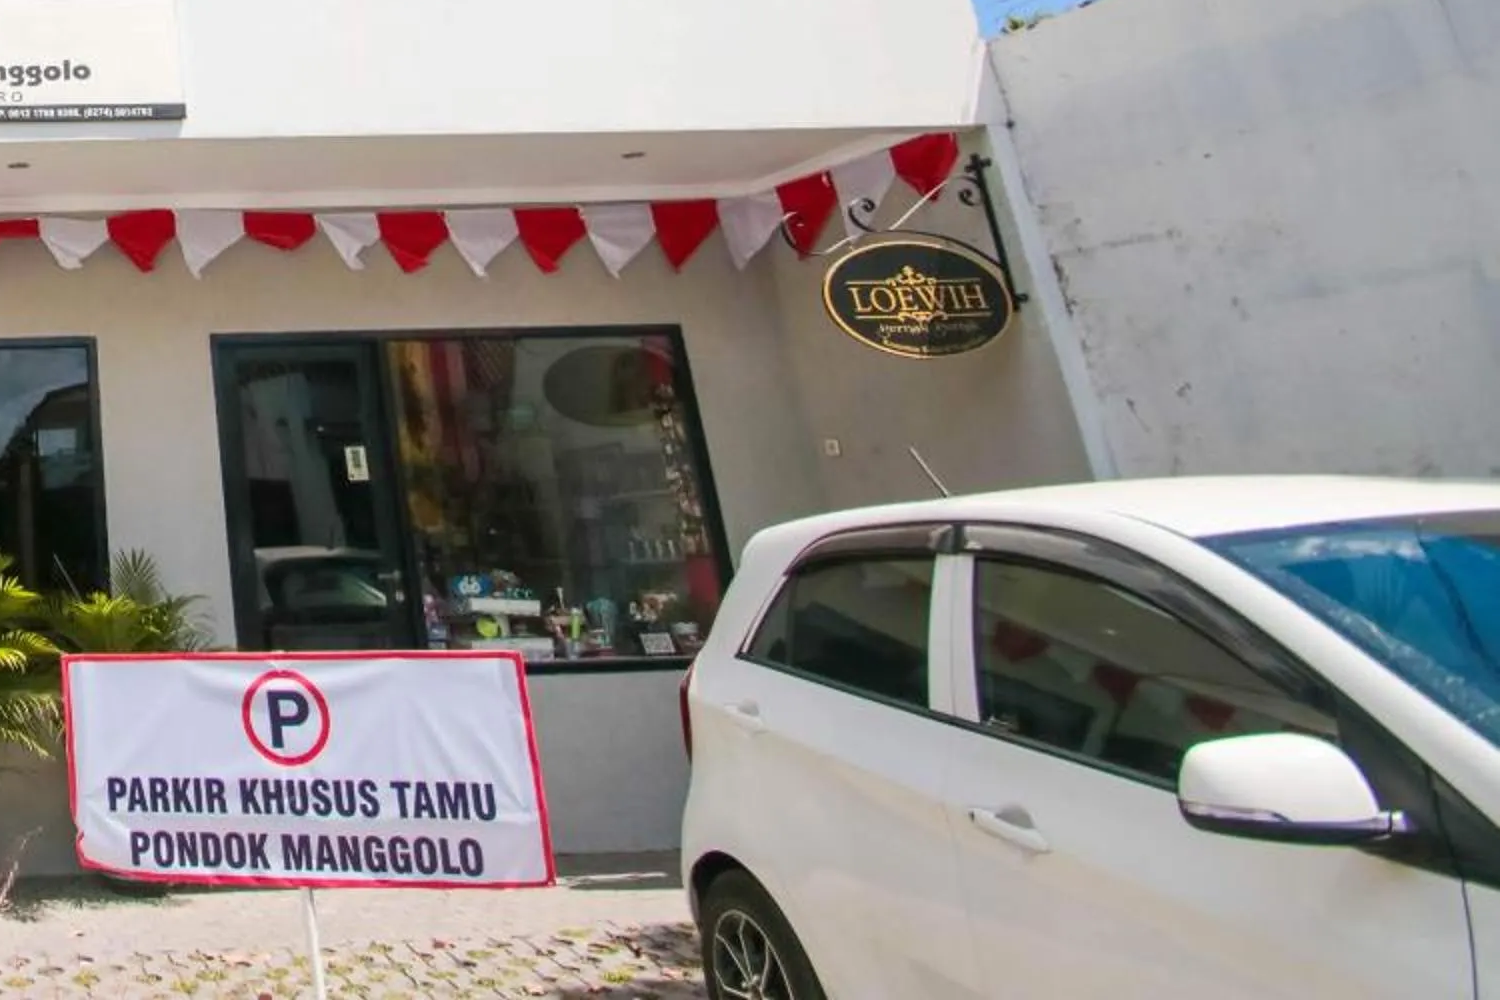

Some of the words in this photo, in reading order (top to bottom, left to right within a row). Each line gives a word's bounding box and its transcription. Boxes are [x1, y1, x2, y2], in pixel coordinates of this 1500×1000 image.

[266, 689, 309, 748] P
[107, 776, 228, 814] PARKIR
[238, 777, 381, 818] KHUSUS
[391, 780, 497, 821] TAMU
[130, 830, 271, 871] PONDOK
[282, 833, 485, 878] MANGGOLO
